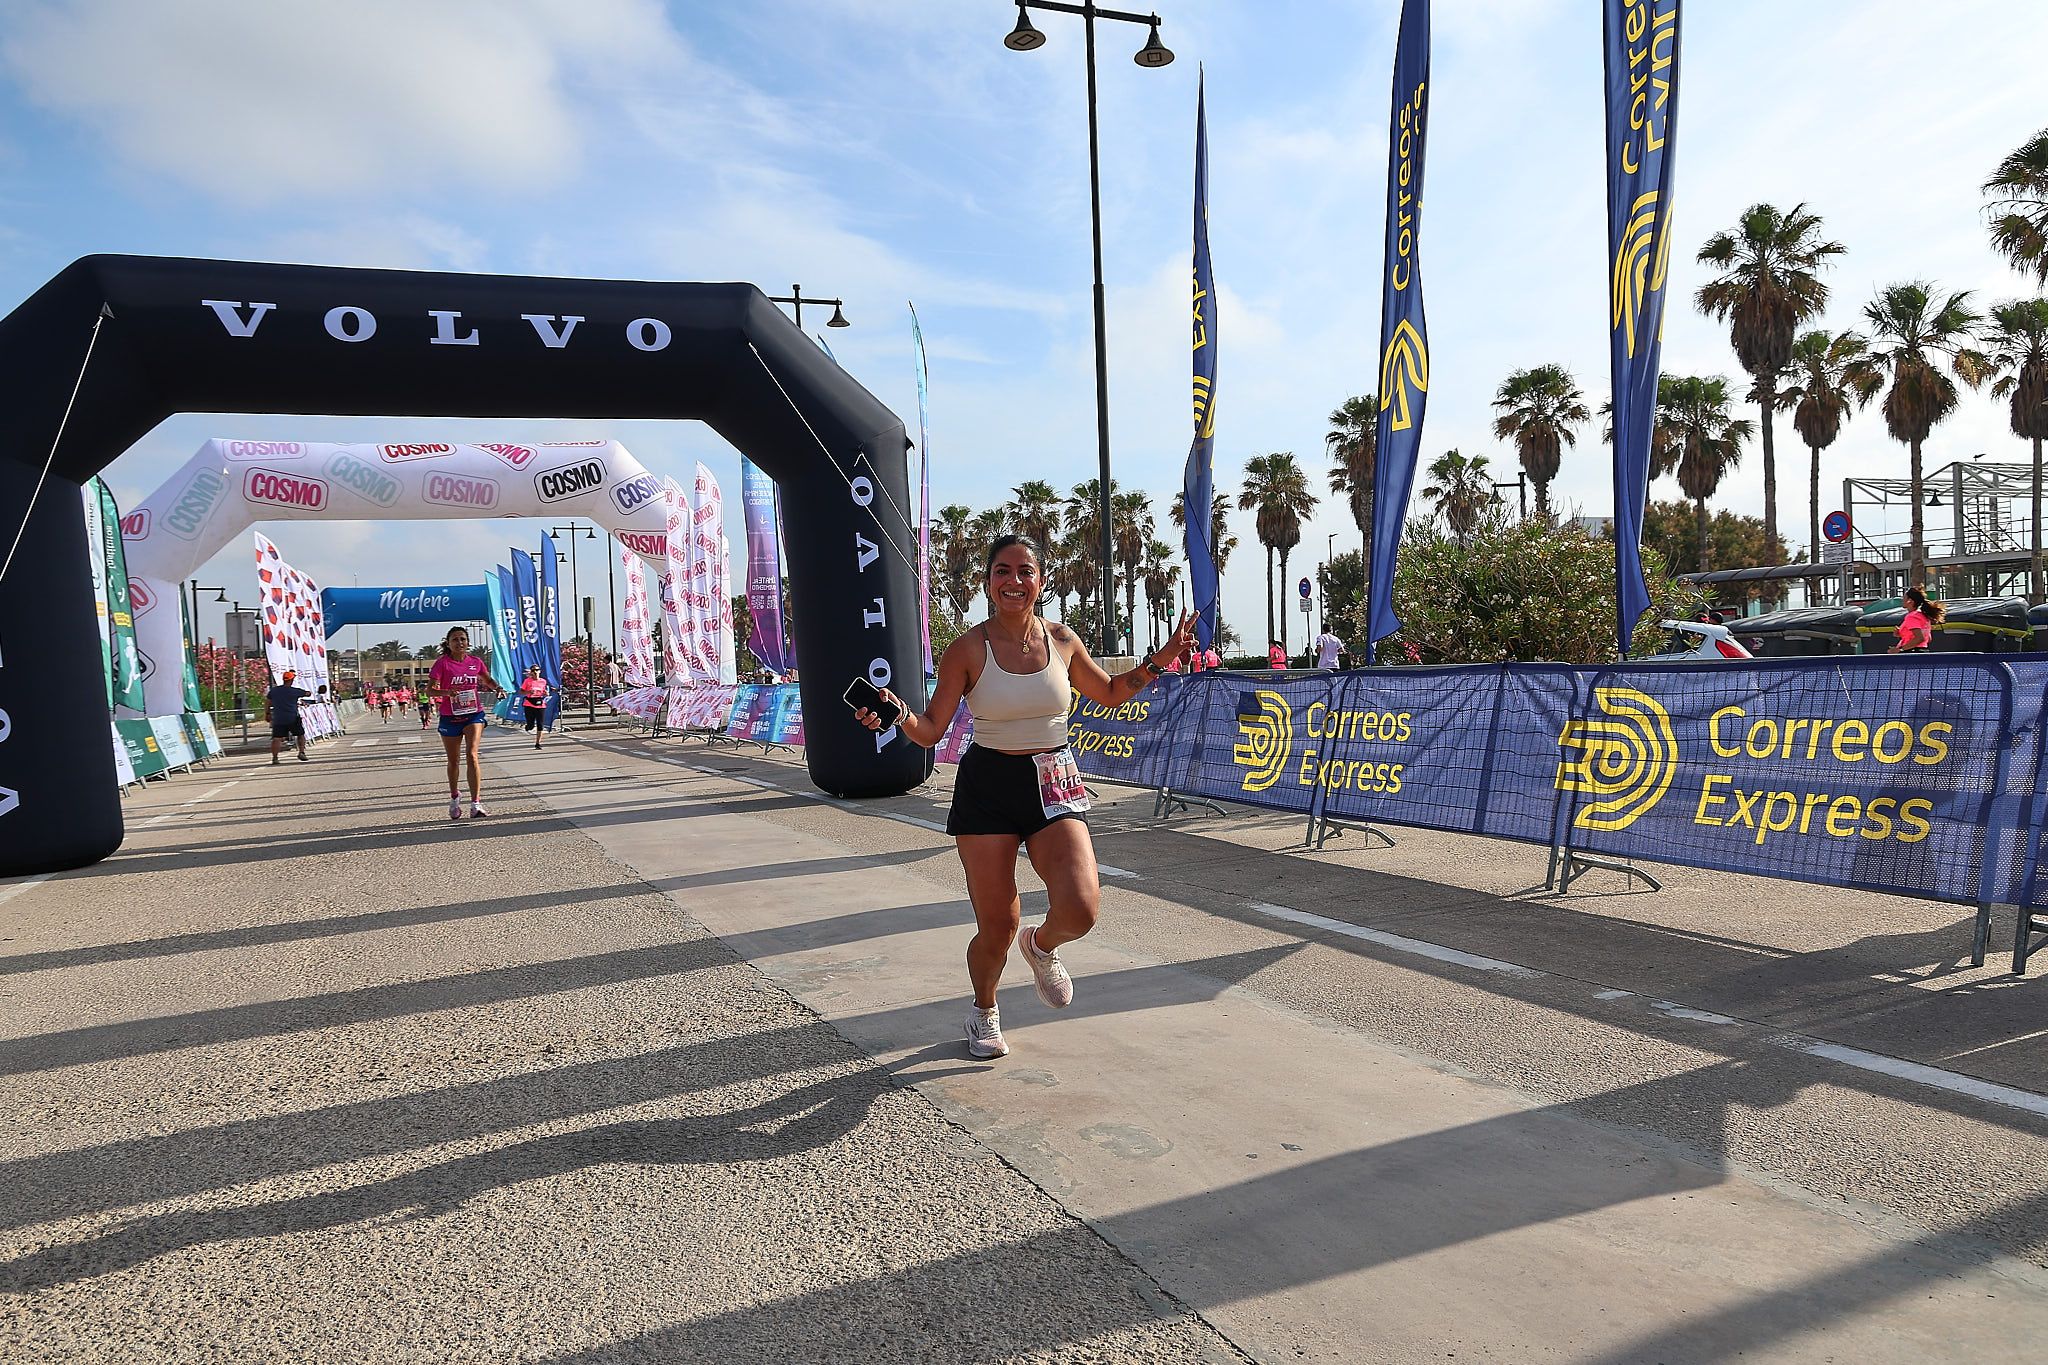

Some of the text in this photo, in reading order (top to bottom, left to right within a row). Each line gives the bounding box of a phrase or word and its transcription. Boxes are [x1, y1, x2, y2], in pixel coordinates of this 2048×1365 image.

[1622, 0, 1647, 174] Corre
[1393, 103, 1411, 291] Correos
[202, 299, 672, 352] VOLVO
[230, 441, 300, 456] COSMO
[251, 472, 322, 507] COSMO
[331, 456, 397, 502] COSMO
[429, 475, 494, 505] COSMO
[541, 462, 602, 498] COSMO
[168, 473, 223, 533] COSMO
[619, 532, 667, 555] COSM
[379, 589, 450, 619] Marlene
[1307, 702, 1411, 742] Correos
[1709, 705, 1953, 766] Correos
[1299, 750, 1403, 797] Express
[1694, 774, 1934, 846] Express
